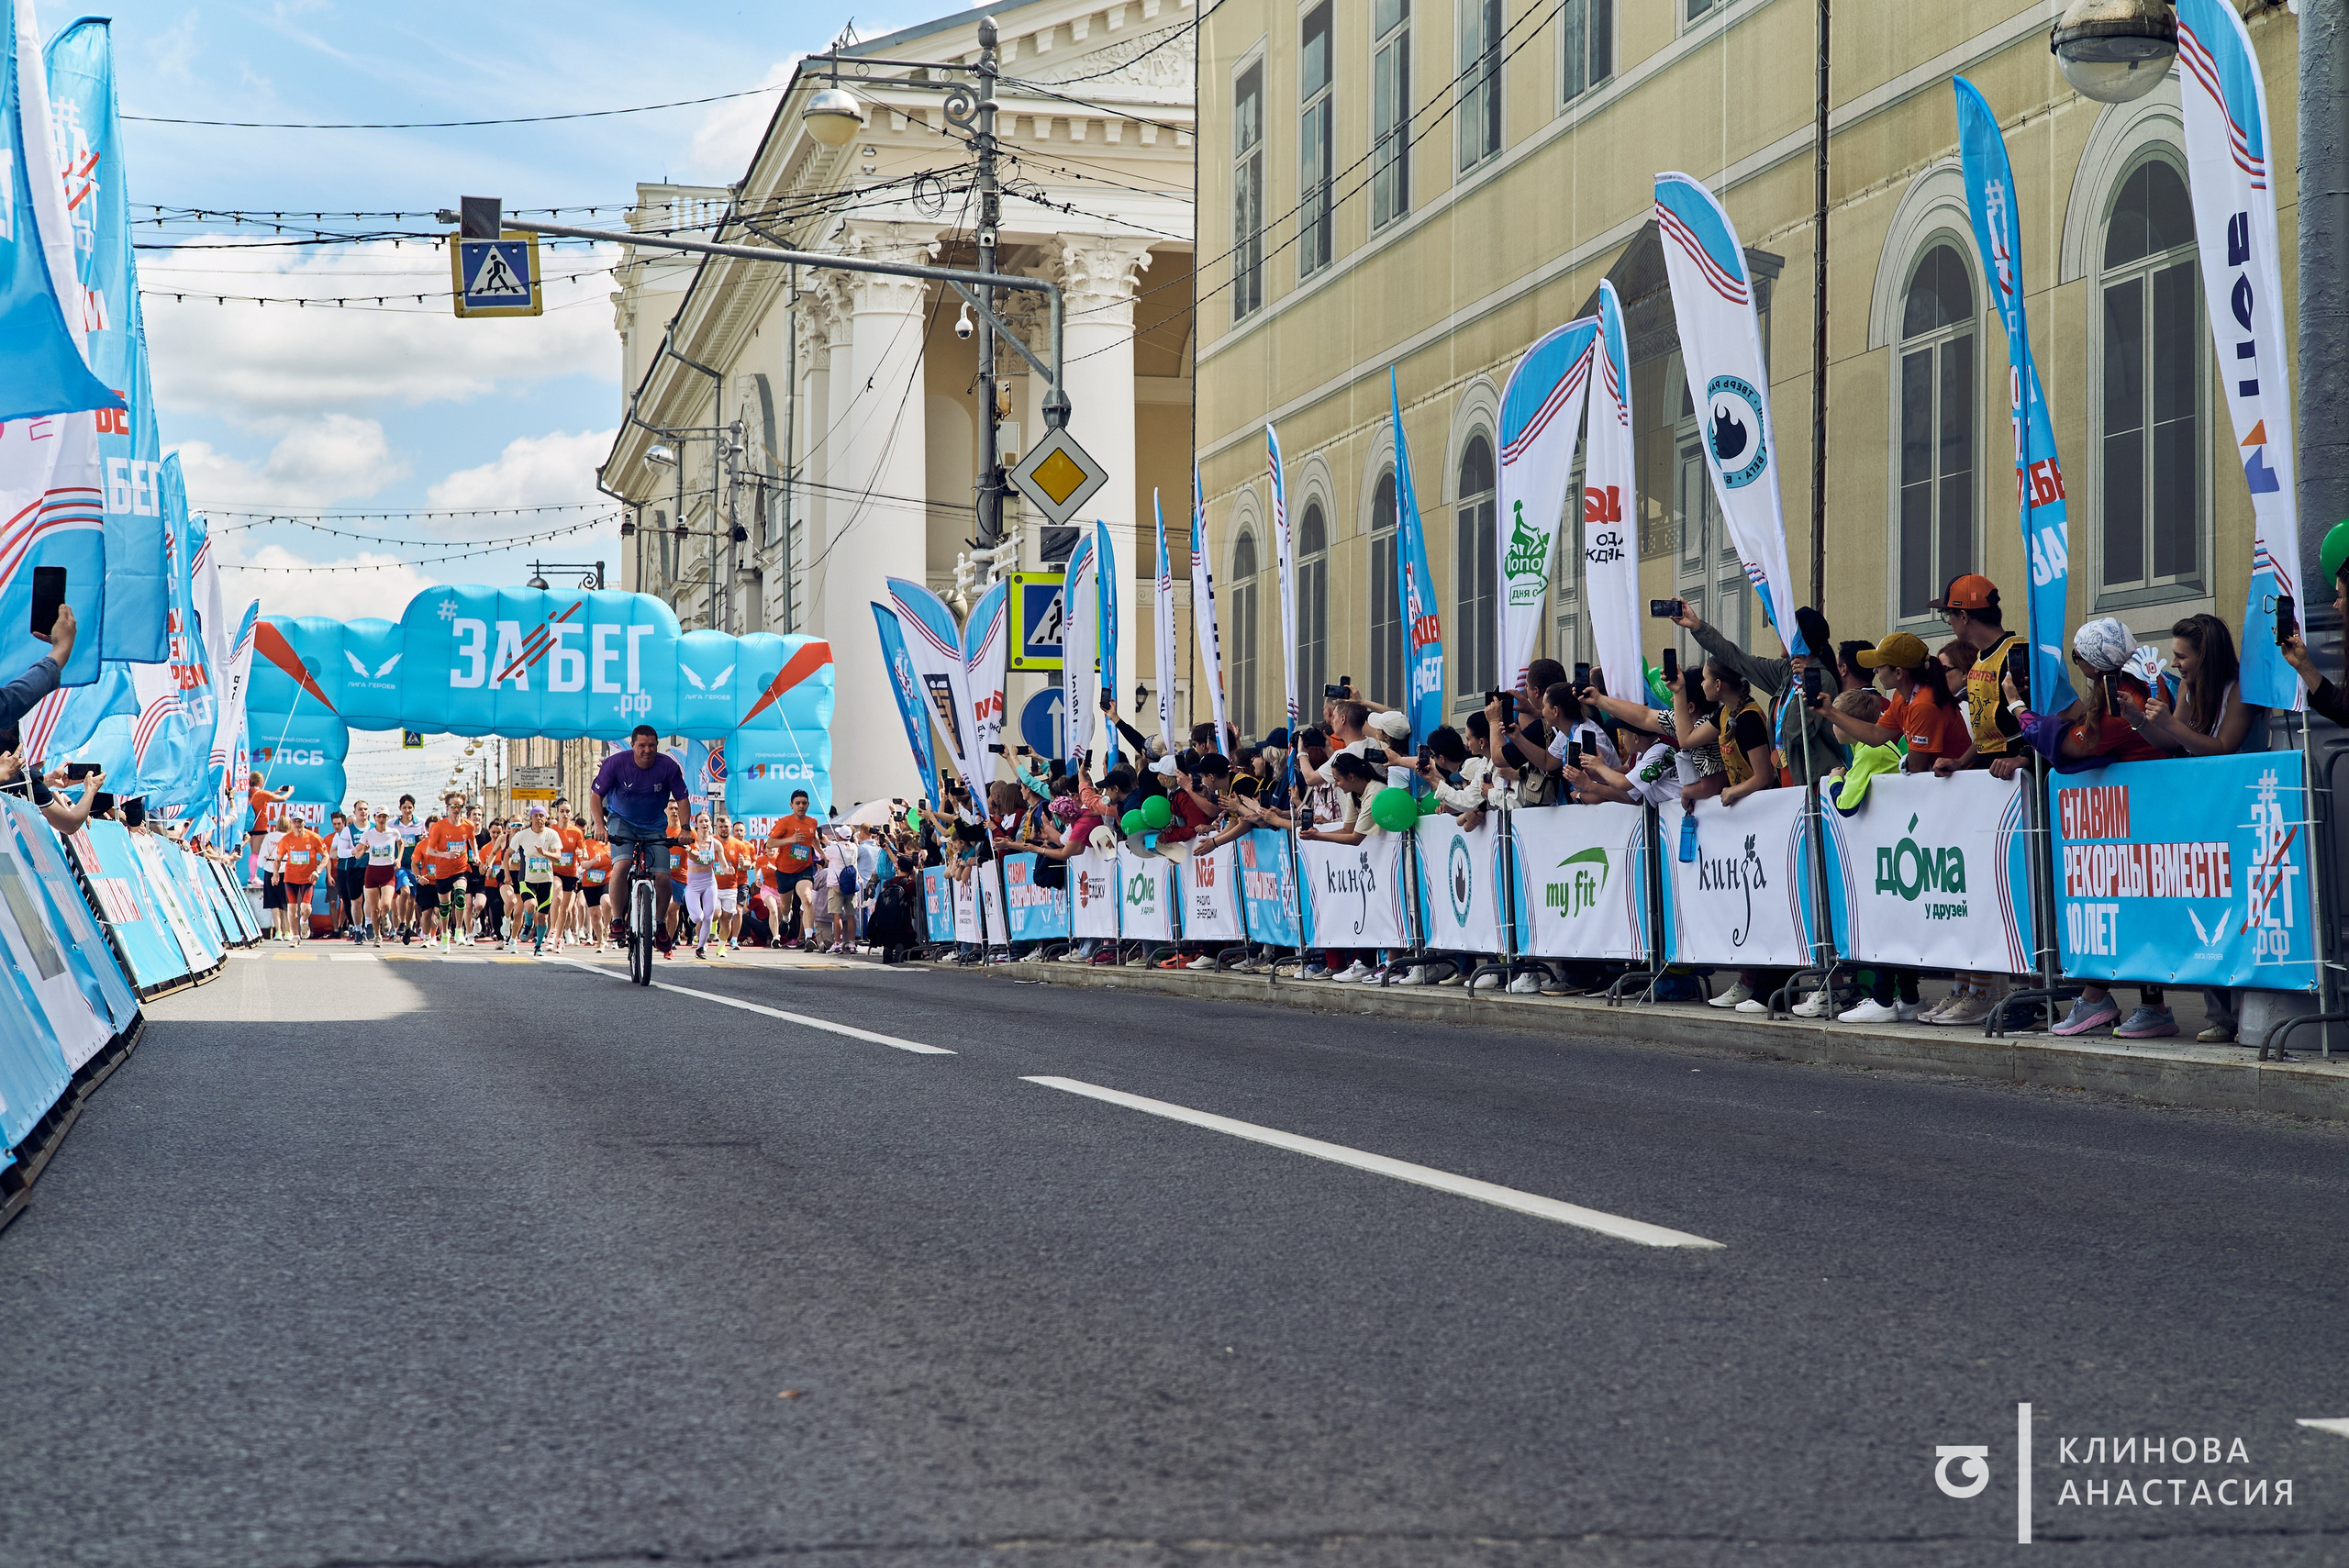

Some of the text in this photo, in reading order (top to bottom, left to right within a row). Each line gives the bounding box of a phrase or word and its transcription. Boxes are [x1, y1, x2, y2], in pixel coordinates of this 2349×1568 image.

[369, 682, 395, 690] ГЕРОЕВ
[277, 748, 325, 766] ПСБ
[770, 763, 815, 780] ПСБ
[2058, 784, 2132, 840] СТАВИМ
[2063, 841, 2232, 898] РЕКОРДЫ ВМЕСТЕ
[1545, 869, 1596, 918] my fit
[1925, 900, 1968, 920] у друзей
[2065, 902, 2120, 956] 10 ЛЕТ
